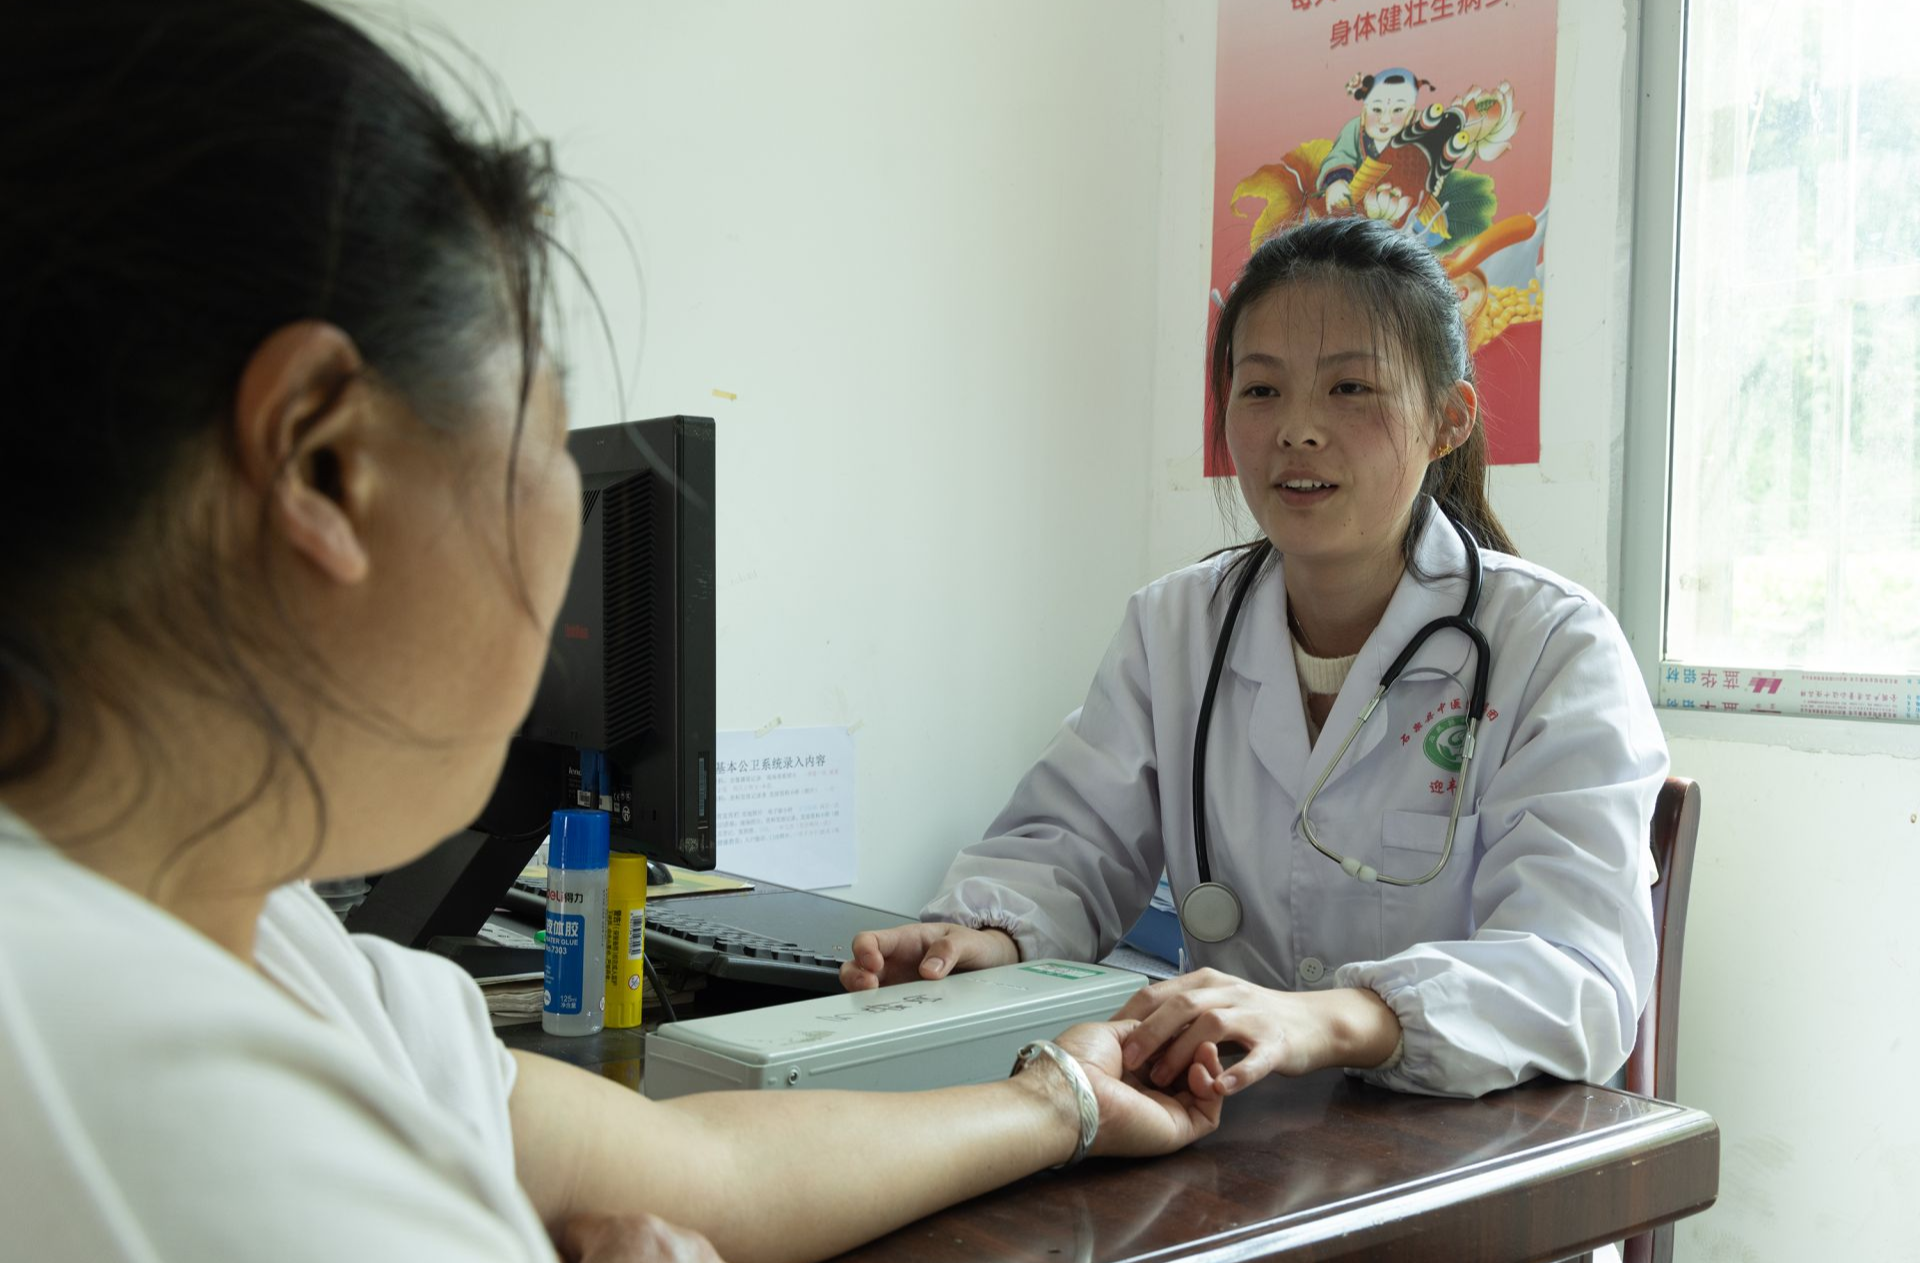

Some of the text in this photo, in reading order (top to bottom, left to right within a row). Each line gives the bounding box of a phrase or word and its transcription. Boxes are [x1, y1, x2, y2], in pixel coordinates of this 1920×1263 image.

[1329, 0, 1501, 49] 身体健壮生病
[1665, 667, 1740, 690] 蓝华铝材
[716, 754, 826, 774] 基本公卫系统录入内容
[560, 938, 579, 946] GLUE
